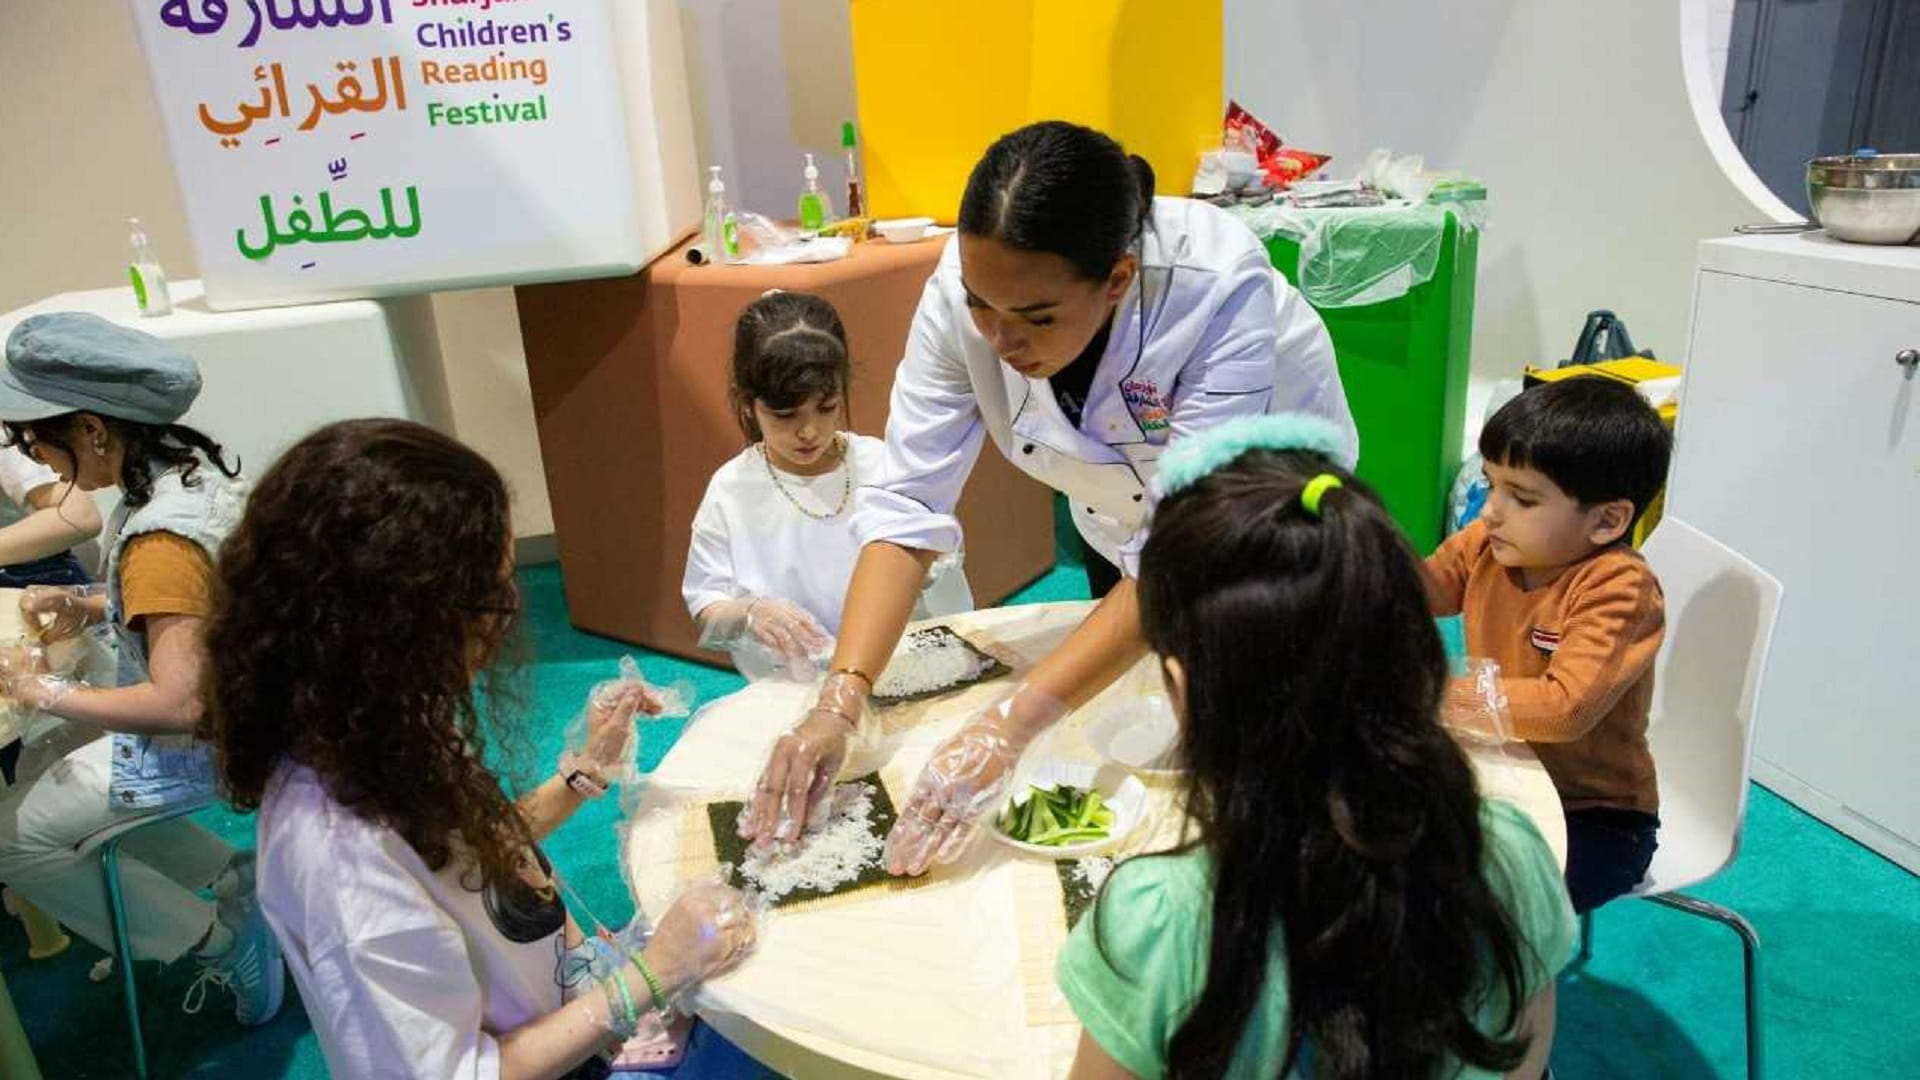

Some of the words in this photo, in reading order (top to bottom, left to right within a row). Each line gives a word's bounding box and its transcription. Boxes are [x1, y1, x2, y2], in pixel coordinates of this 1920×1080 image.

[416, 13, 572, 48] Children's
[420, 52, 549, 86] Reading
[427, 94, 547, 127] Festival
